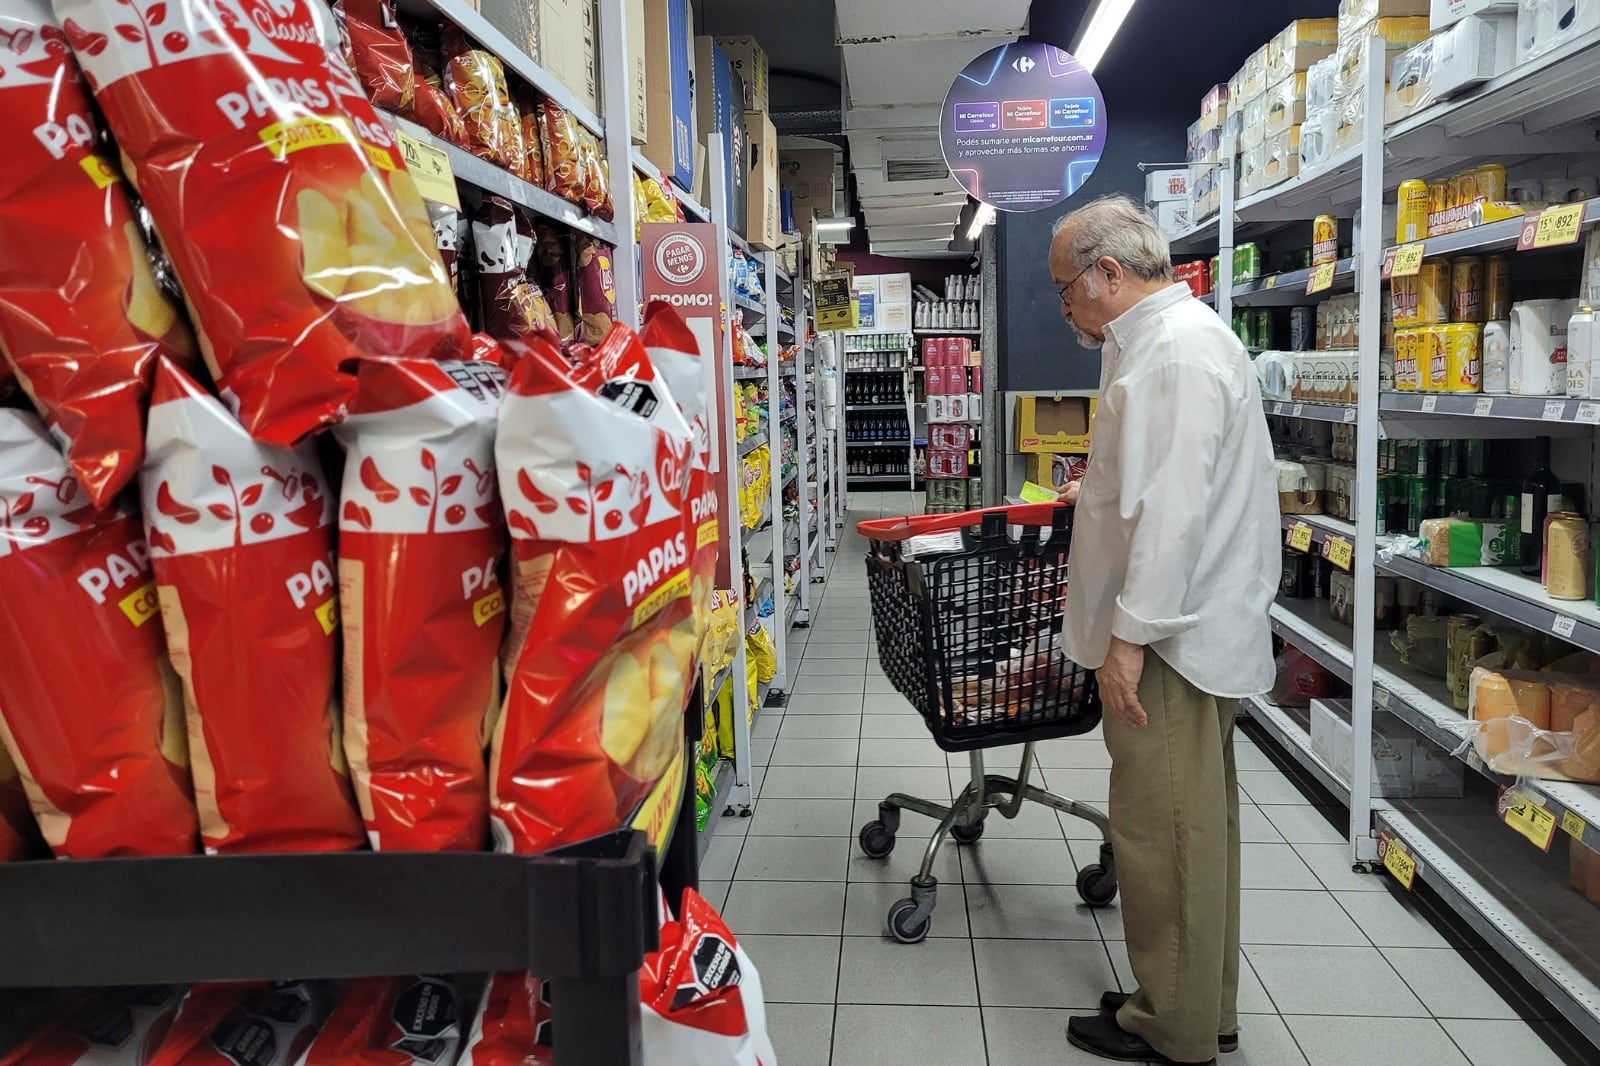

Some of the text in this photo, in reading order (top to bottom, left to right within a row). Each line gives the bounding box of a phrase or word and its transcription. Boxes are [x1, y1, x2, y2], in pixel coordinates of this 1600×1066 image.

[216, 77, 330, 130] PAPAS
[956, 138, 979, 147] Podés
[981, 137, 1010, 145] sumarte
[1022, 134, 1093, 143] micarrefour.com.ar
[965, 147, 1005, 156] aprovechar
[1007, 146, 1022, 154] más
[1024, 146, 1049, 154] formas
[1061, 144, 1089, 152] ahorrar.
[665, 245, 691, 258] PAGAR
[667, 253, 693, 267] MENOS
[622, 531, 687, 608] PAPAS
[702, 941, 726, 985] EXCESO EN
